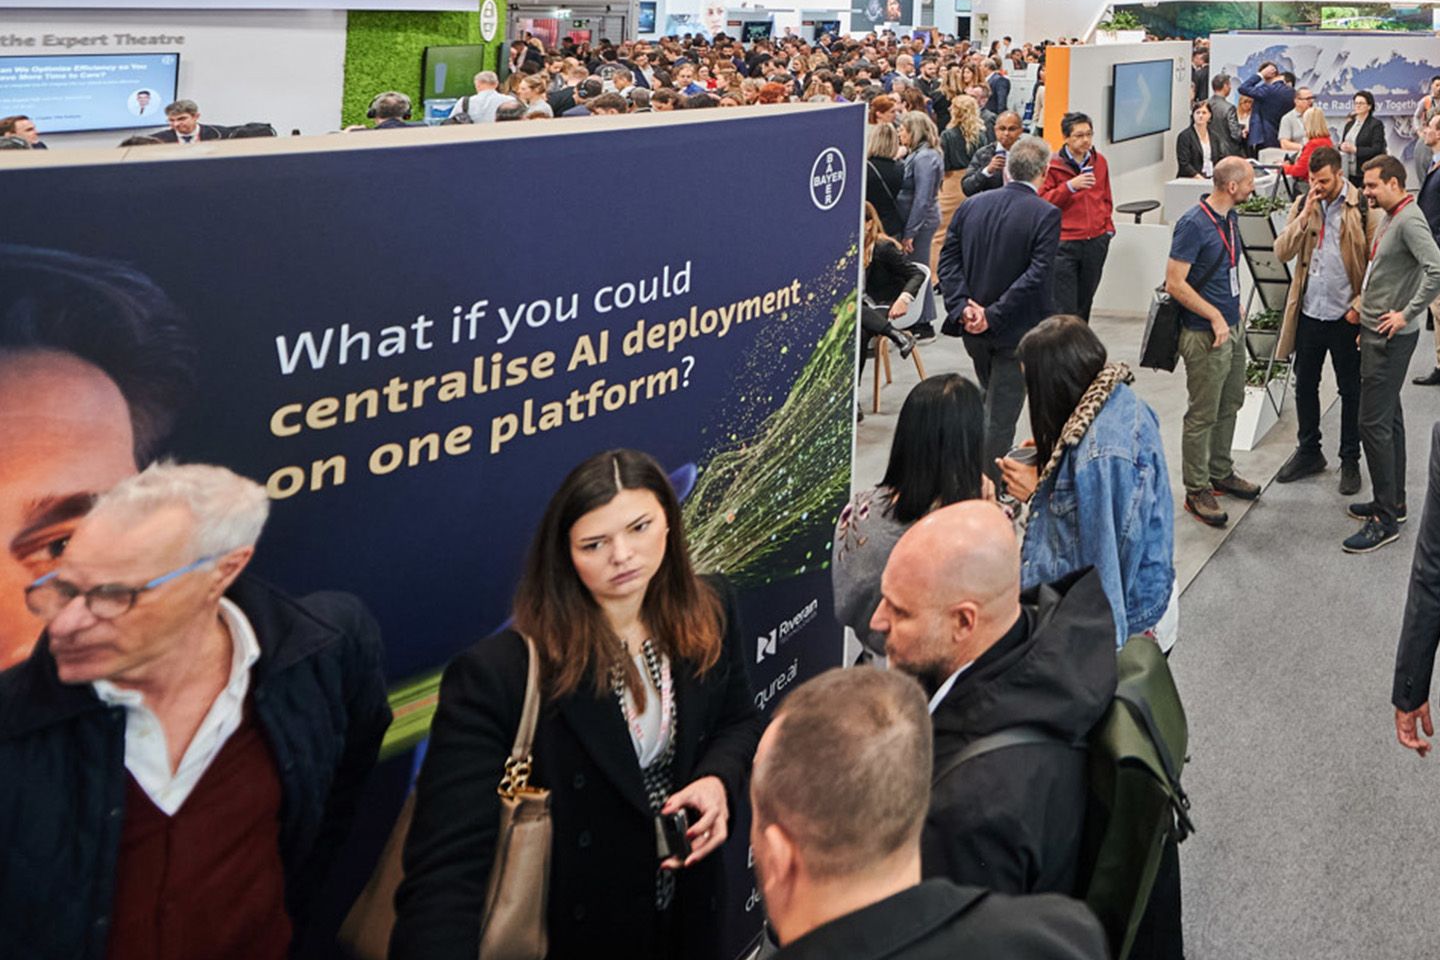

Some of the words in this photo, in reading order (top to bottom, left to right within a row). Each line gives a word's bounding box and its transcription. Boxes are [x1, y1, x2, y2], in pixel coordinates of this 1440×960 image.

[42, 33, 108, 48] Expert
[114, 33, 185, 46] Theatre
[813, 170, 844, 188] BAYER
[825, 152, 834, 205] BAYER
[274, 312, 435, 376] What
[450, 298, 489, 342] if
[497, 292, 579, 344] you
[594, 261, 692, 314] could
[269, 350, 556, 438] centralise
[566, 333, 609, 373] AI
[621, 278, 802, 356] deployment
[264, 454, 346, 501] on
[368, 425, 474, 476] one
[489, 355, 696, 454] platform?
[779, 598, 818, 638] Riverain
[753, 657, 799, 711] qure.ai
